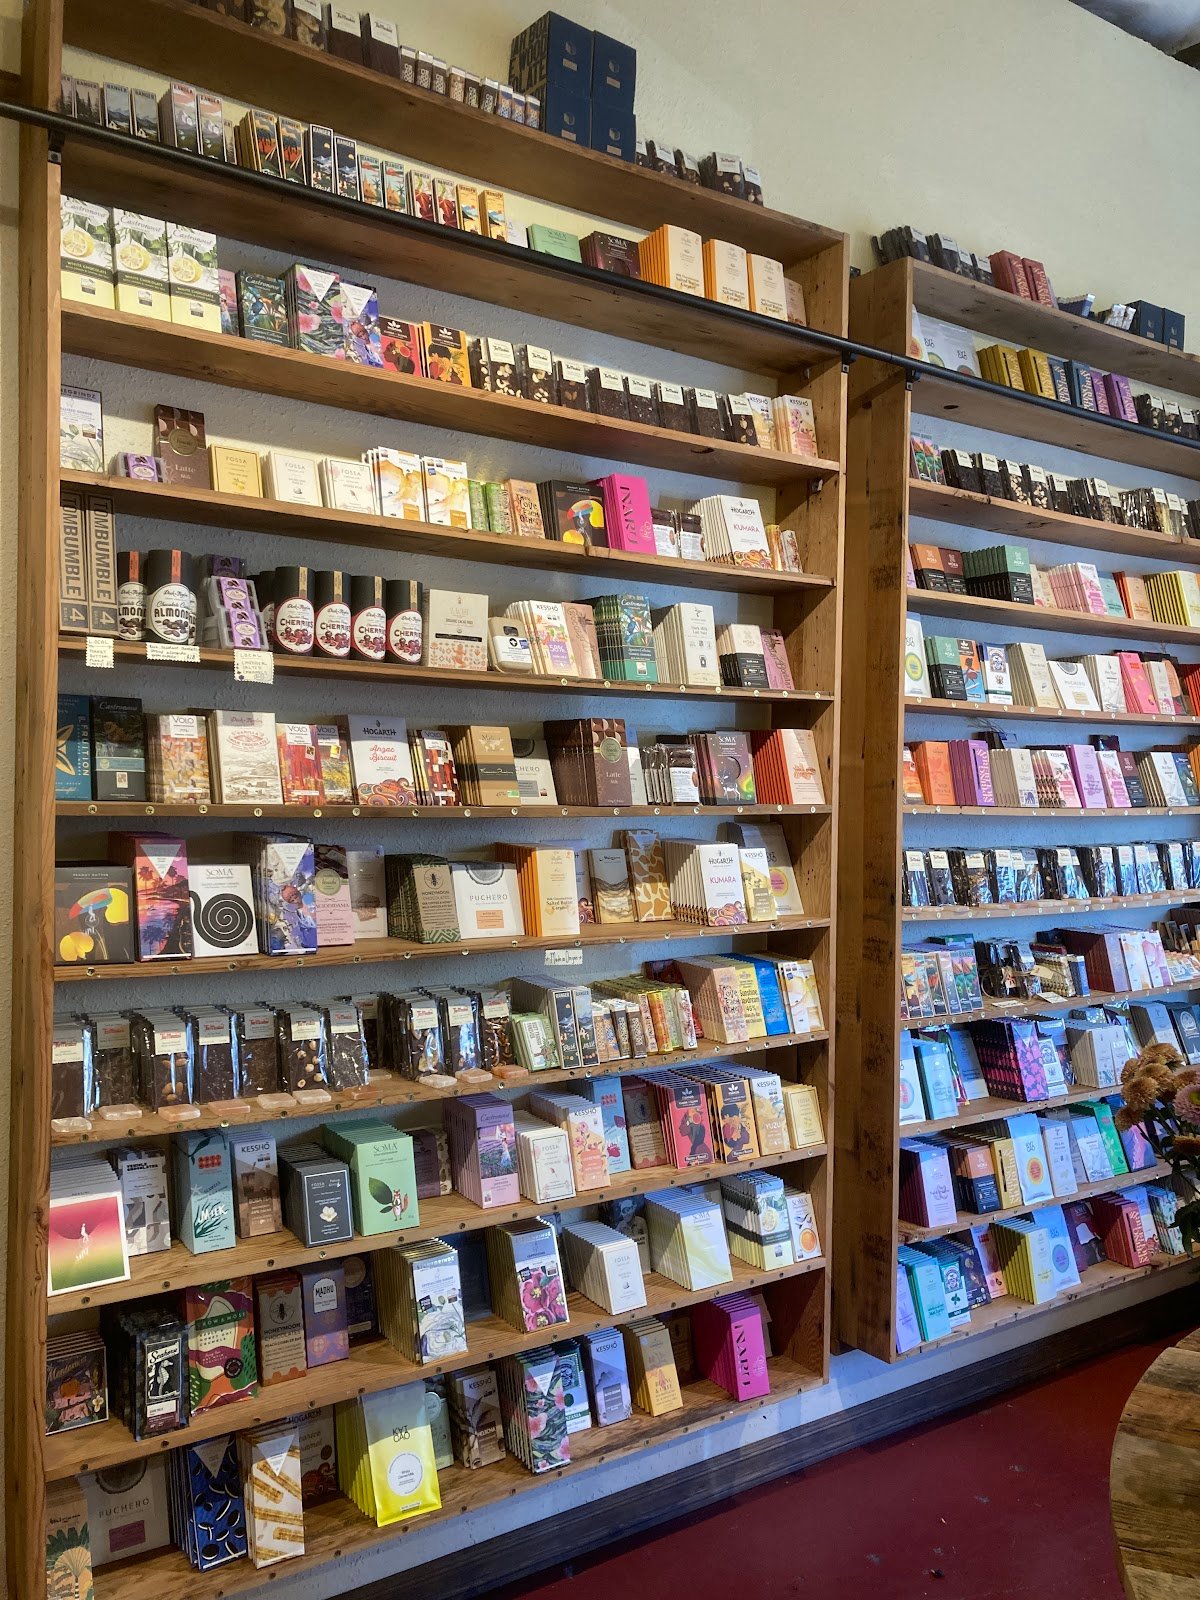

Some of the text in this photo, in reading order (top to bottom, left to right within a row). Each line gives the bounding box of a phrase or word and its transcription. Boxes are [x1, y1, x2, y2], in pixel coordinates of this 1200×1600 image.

[226, 455, 248, 465] FOSSA
[285, 462, 306, 471] FOSSA
[341, 469, 363, 478] FOSSA
[733, 523, 760, 534] KUMARA
[60, 497, 82, 599] TOMBUMBLE
[93, 499, 112, 601] TOMBUMBLE
[69, 607, 84, 622] 4
[99, 611, 112, 625] 4
[173, 716, 195, 725] VOLO
[287, 725, 308, 733] VOLO
[362, 727, 397, 737] HOGARTH
[424, 731, 442, 739] VOLO
[82, 725, 90, 776] FRUITION
[369, 744, 395, 753] Anzac
[369, 753, 398, 763] Biscuit
[205, 867, 234, 877] SOMA
[709, 876, 737, 884] KUMARA
[373, 1142, 399, 1153] SOMA
[315, 1284, 335, 1298] MADHU
[264, 1323, 301, 1334] HONEYMOON
[98, 1497, 151, 1519] PUCHERO
